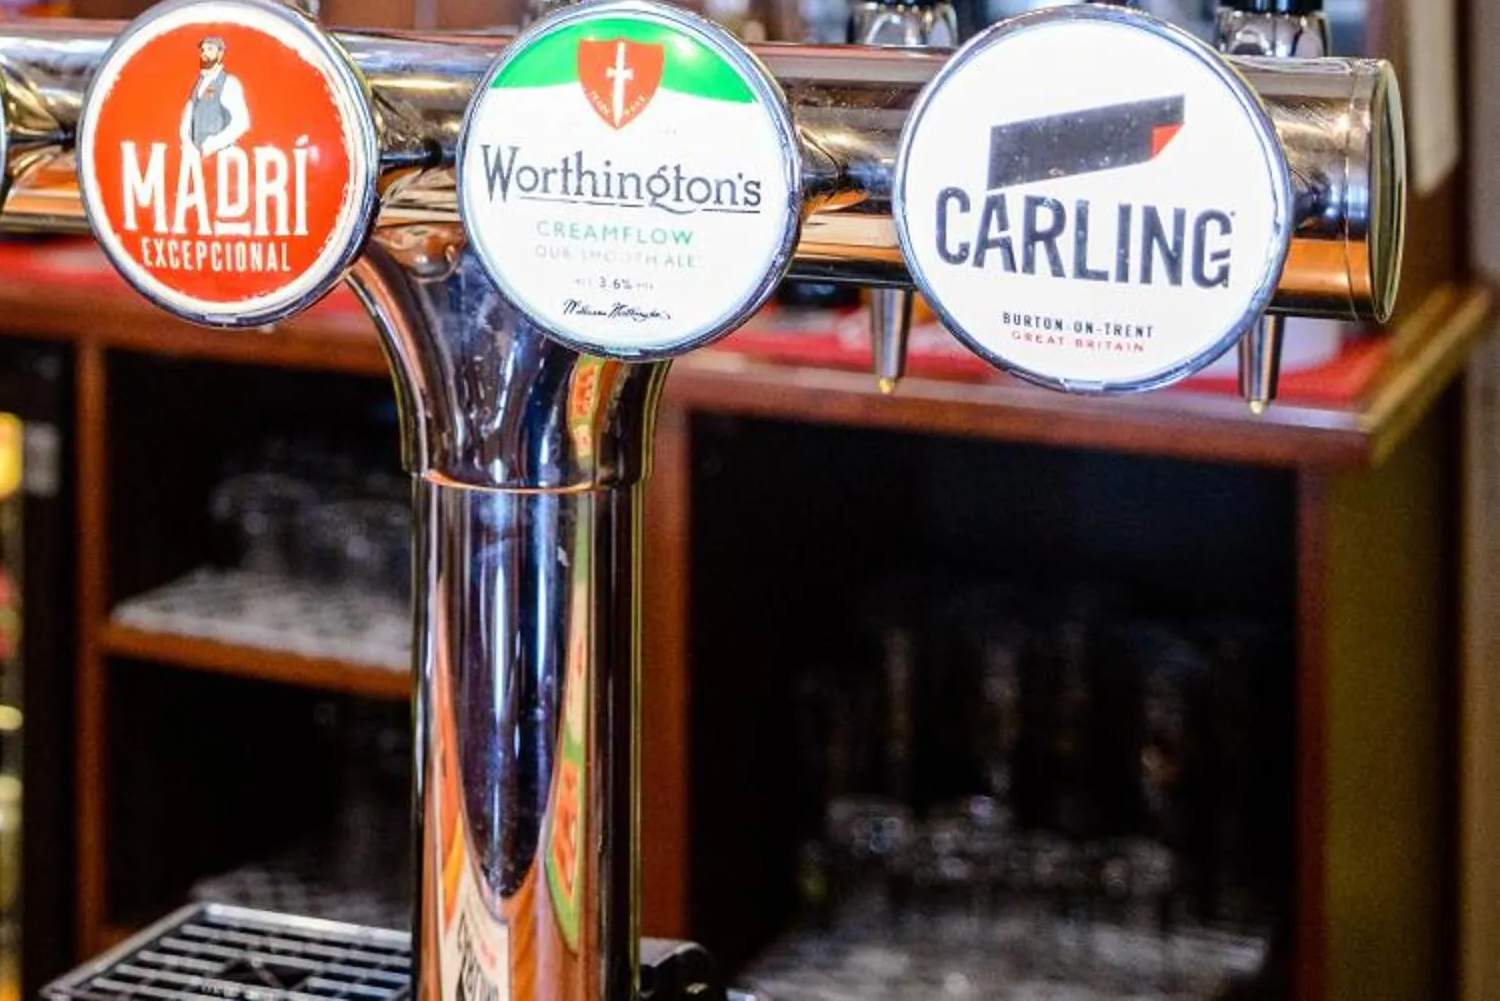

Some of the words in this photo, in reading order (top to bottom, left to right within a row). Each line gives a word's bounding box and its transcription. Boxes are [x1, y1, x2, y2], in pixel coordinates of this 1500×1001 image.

[120, 134, 309, 237] MADRÍ
[481, 144, 762, 215] Worthington's
[536, 220, 694, 246] CREAMFLOW
[935, 186, 1236, 290] CARLING
[140, 236, 291, 272] EXCEPCIONAL
[666, 253, 696, 268] ALE
[1011, 330, 1065, 347] GREAT
[1075, 337, 1146, 353] BRITAIN
